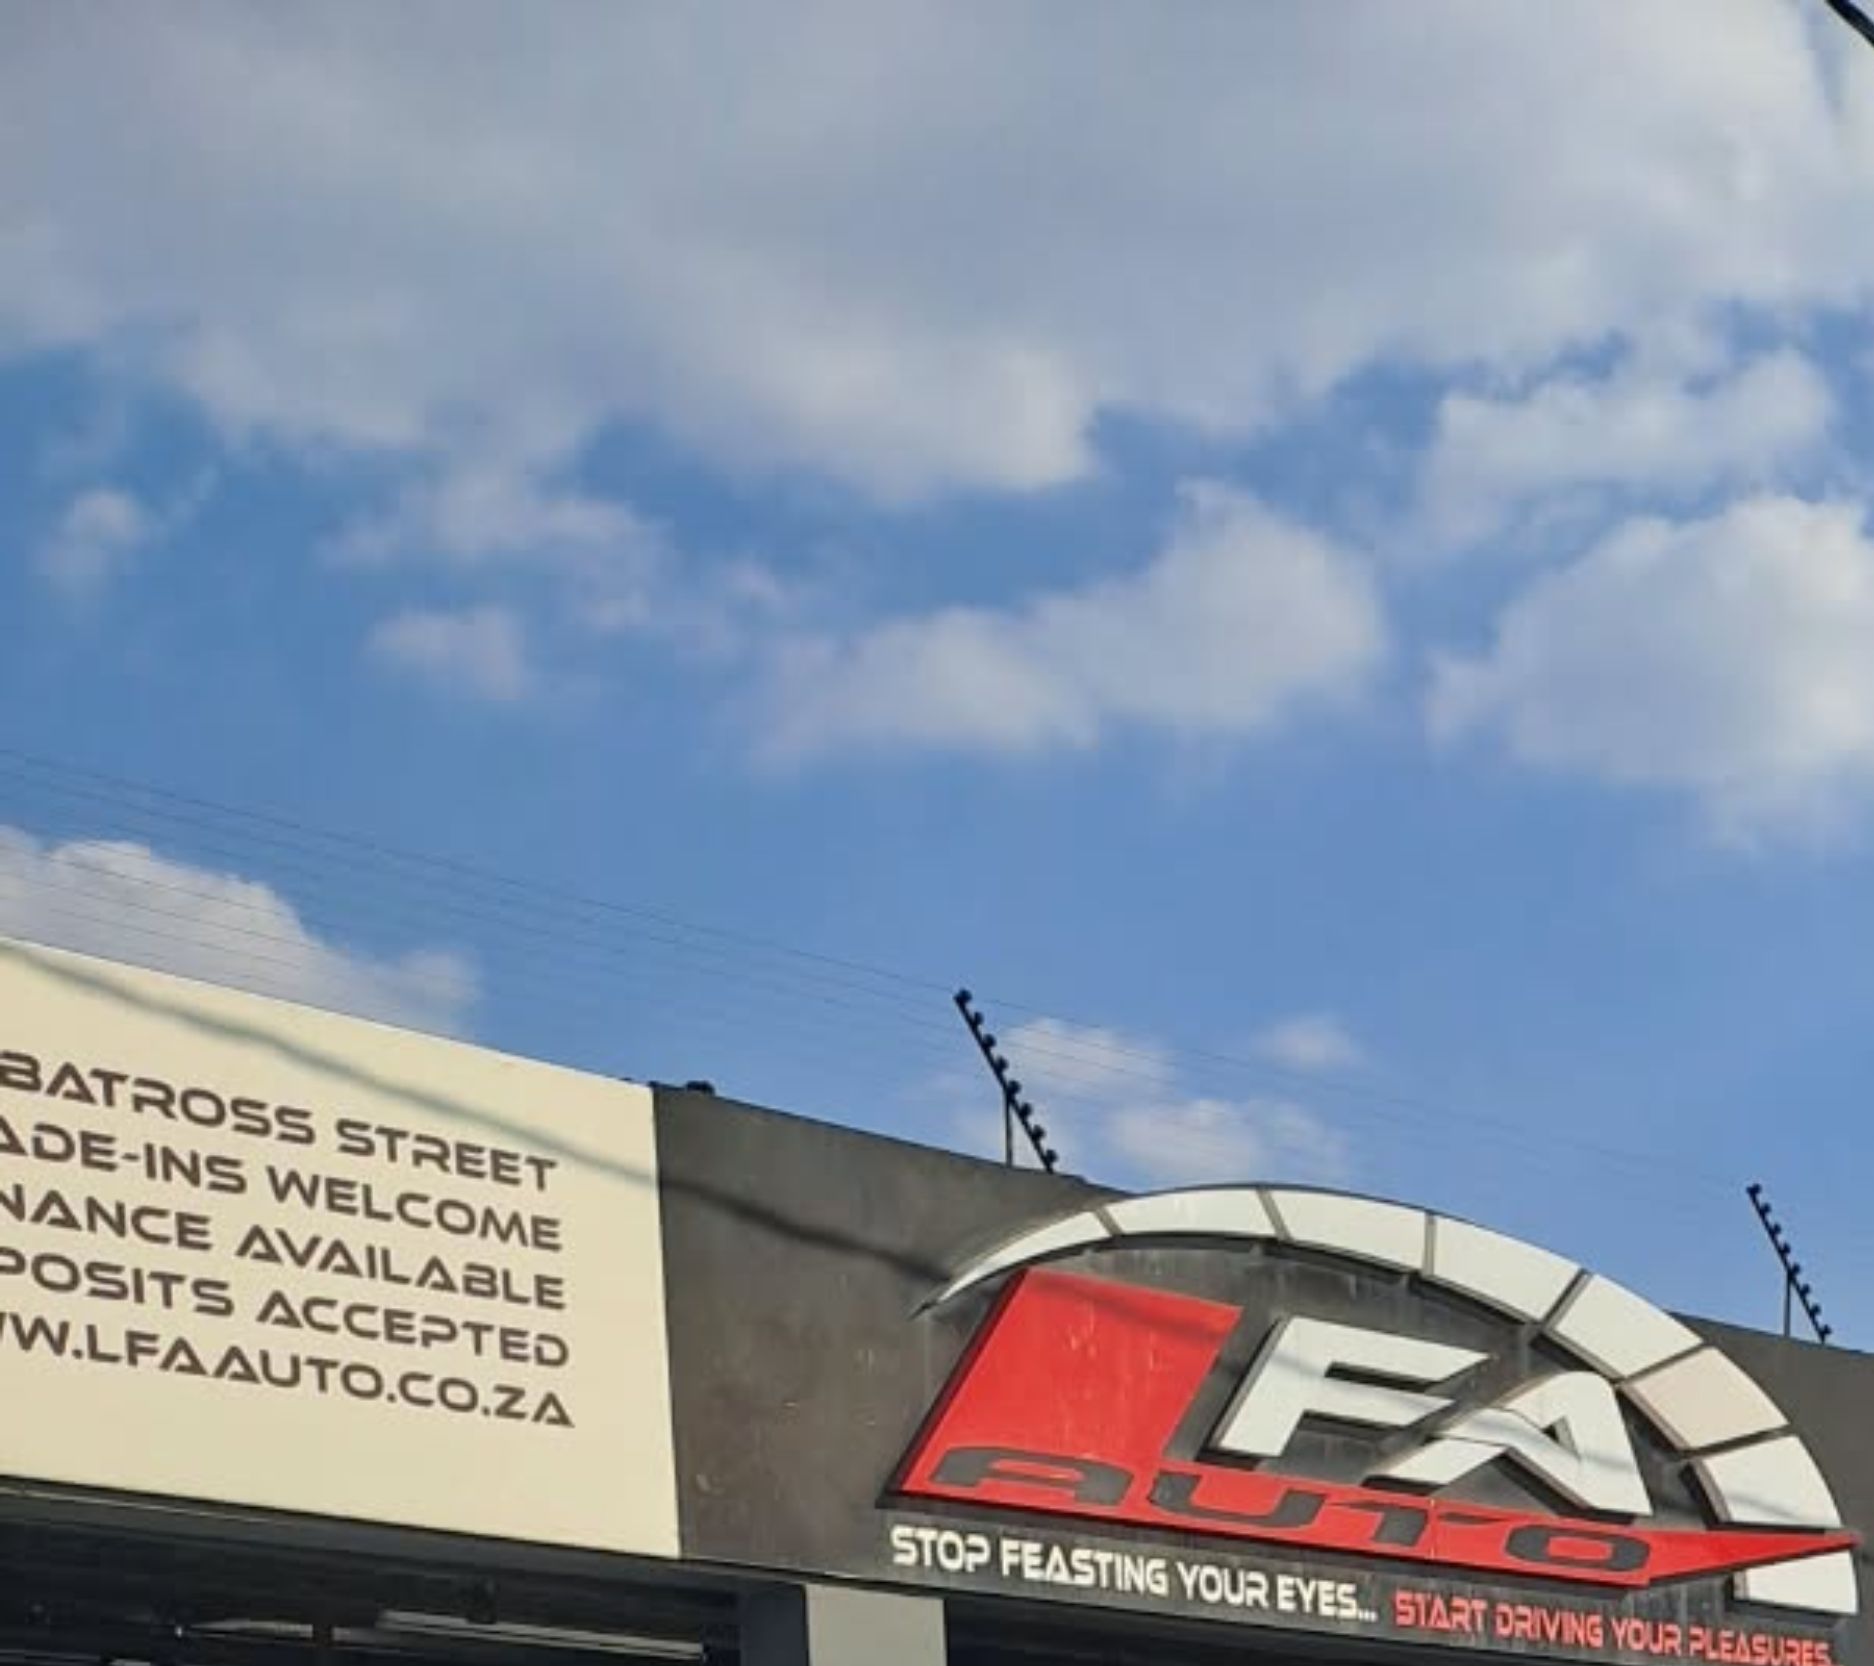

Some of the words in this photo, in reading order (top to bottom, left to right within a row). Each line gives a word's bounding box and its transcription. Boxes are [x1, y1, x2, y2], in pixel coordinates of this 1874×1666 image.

[335, 1118, 557, 1192] STREET
[266, 1164, 563, 1253] WELCOME
[235, 1223, 566, 1311] AVAILABLE
[0, 1312, 574, 1428] W.LFAAUTO.CO.ZA
[256, 1289, 570, 1368] ACCEPTED
[930, 1445, 1652, 1572] AUTO
[890, 1524, 991, 1574] STOP
[1000, 1538, 1168, 1596] FEASTING
[1176, 1561, 1268, 1611] YOUR
[1276, 1575, 1378, 1623] EYES...
[1395, 1589, 1486, 1632] START
[1495, 1602, 1603, 1648] DRIVING
[1609, 1616, 1682, 1657] YOUR
